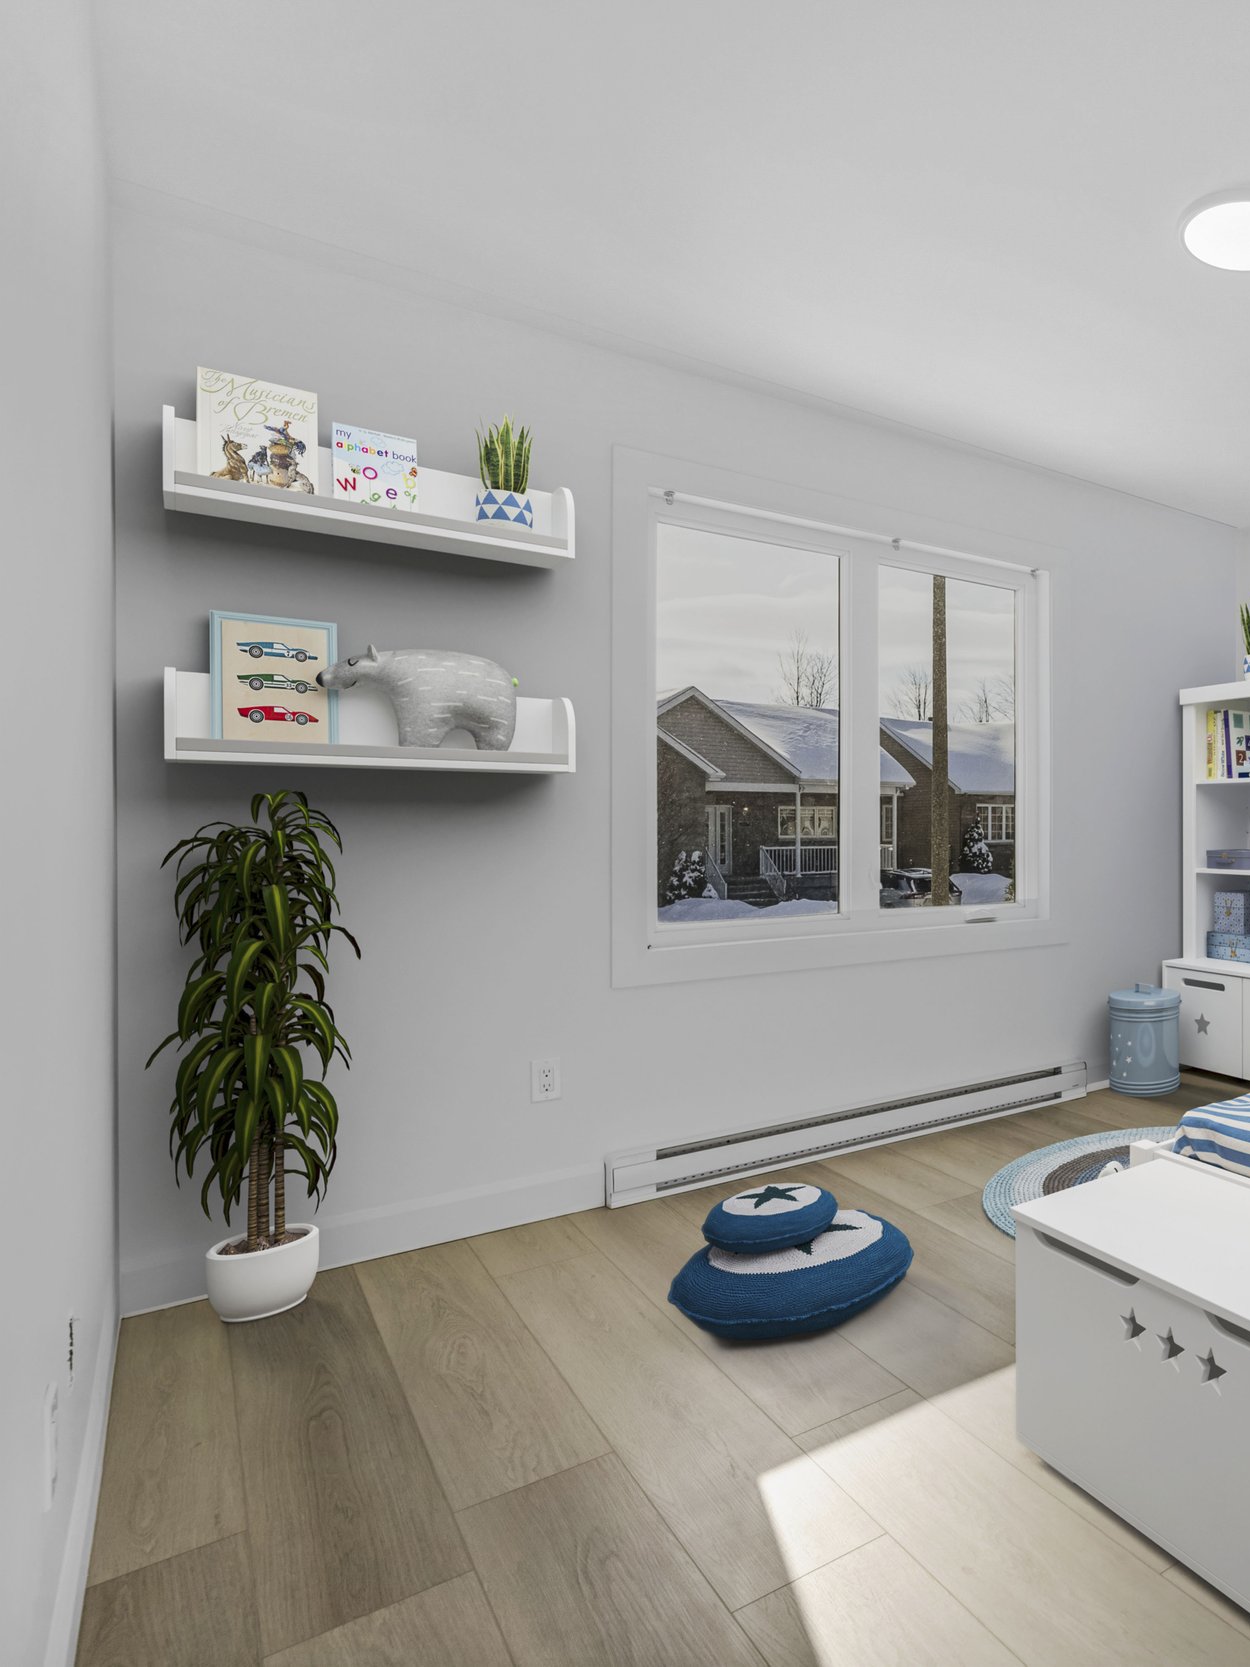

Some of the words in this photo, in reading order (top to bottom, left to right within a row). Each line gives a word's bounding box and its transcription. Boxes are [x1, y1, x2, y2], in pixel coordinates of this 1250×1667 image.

[200, 378, 316, 414] Musicians
[214, 397, 240, 414] of
[234, 400, 308, 425] Bremen
[336, 429, 351, 440] my
[336, 441, 389, 458] alphabet
[392, 451, 417, 463] book
